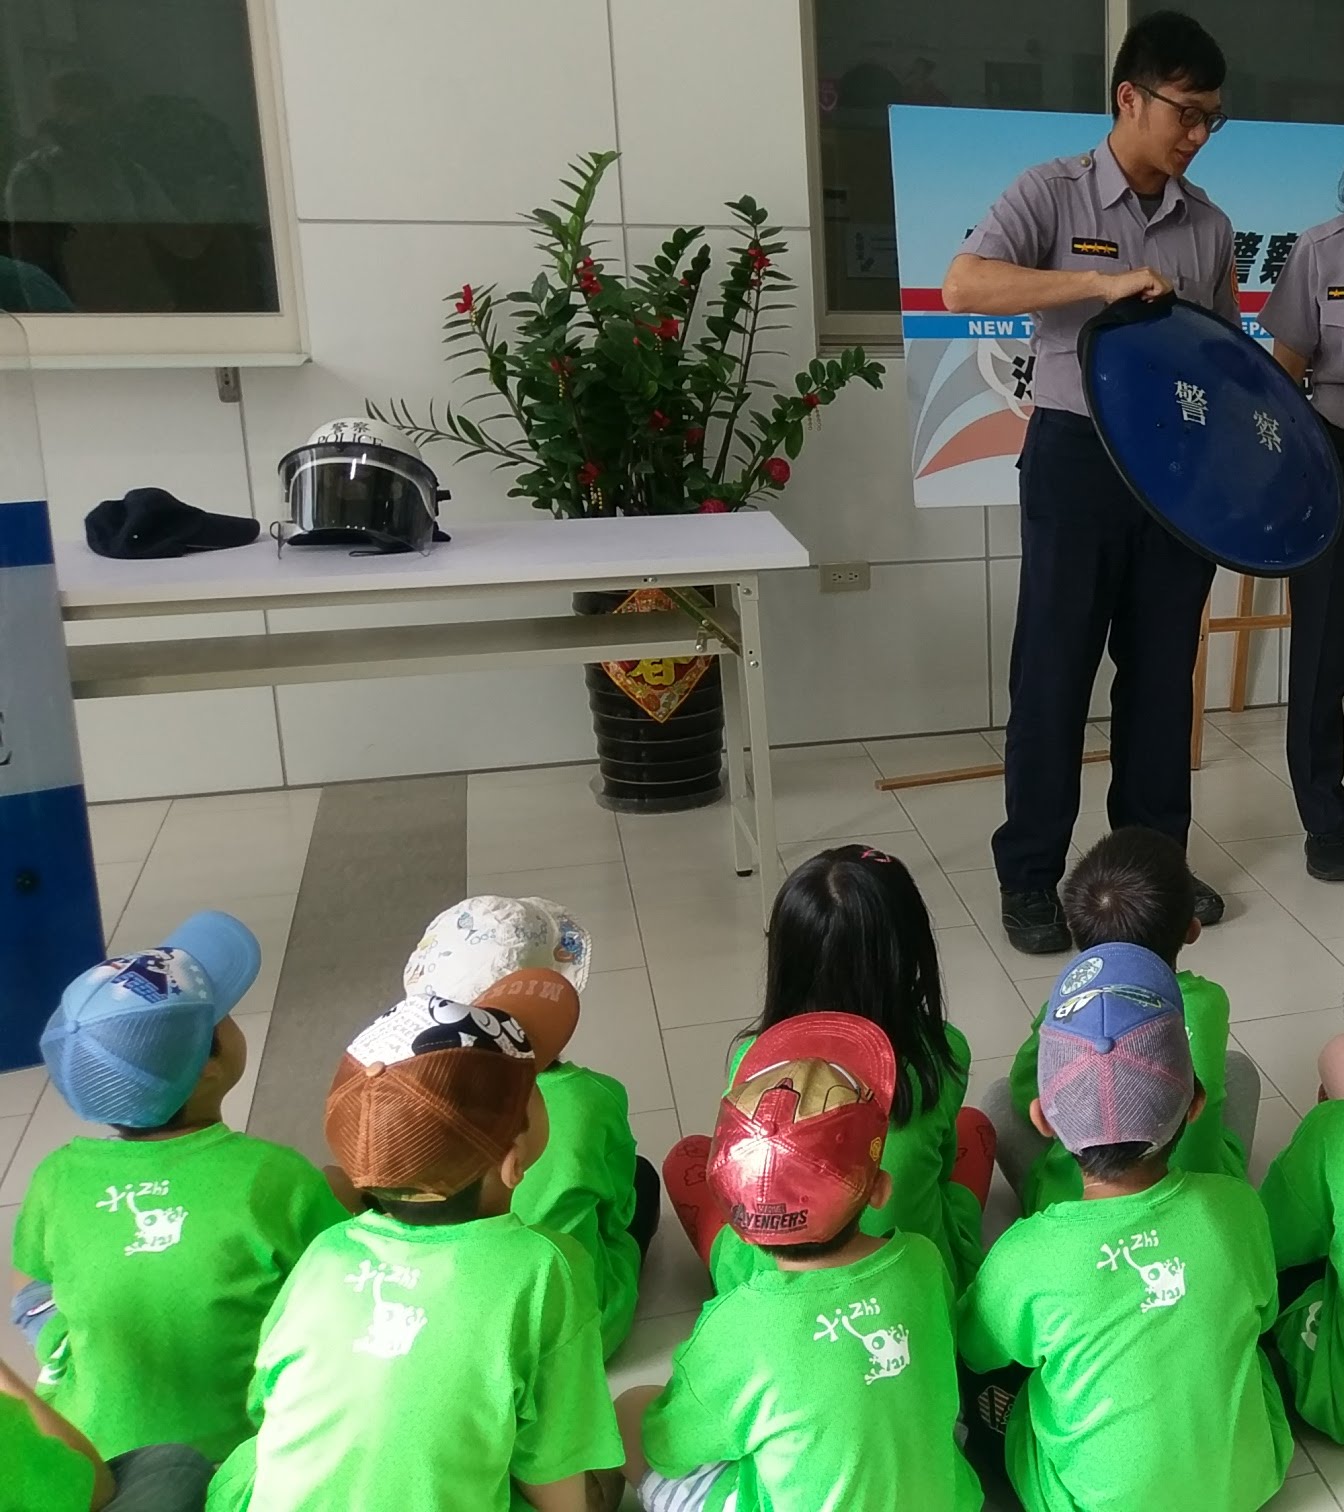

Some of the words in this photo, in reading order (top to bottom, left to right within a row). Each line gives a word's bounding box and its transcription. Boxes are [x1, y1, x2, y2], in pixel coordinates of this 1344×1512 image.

[968, 320, 1014, 336] NEW
[317, 432, 384, 447] POLICE
[731, 1203, 808, 1230] AVENGERS
